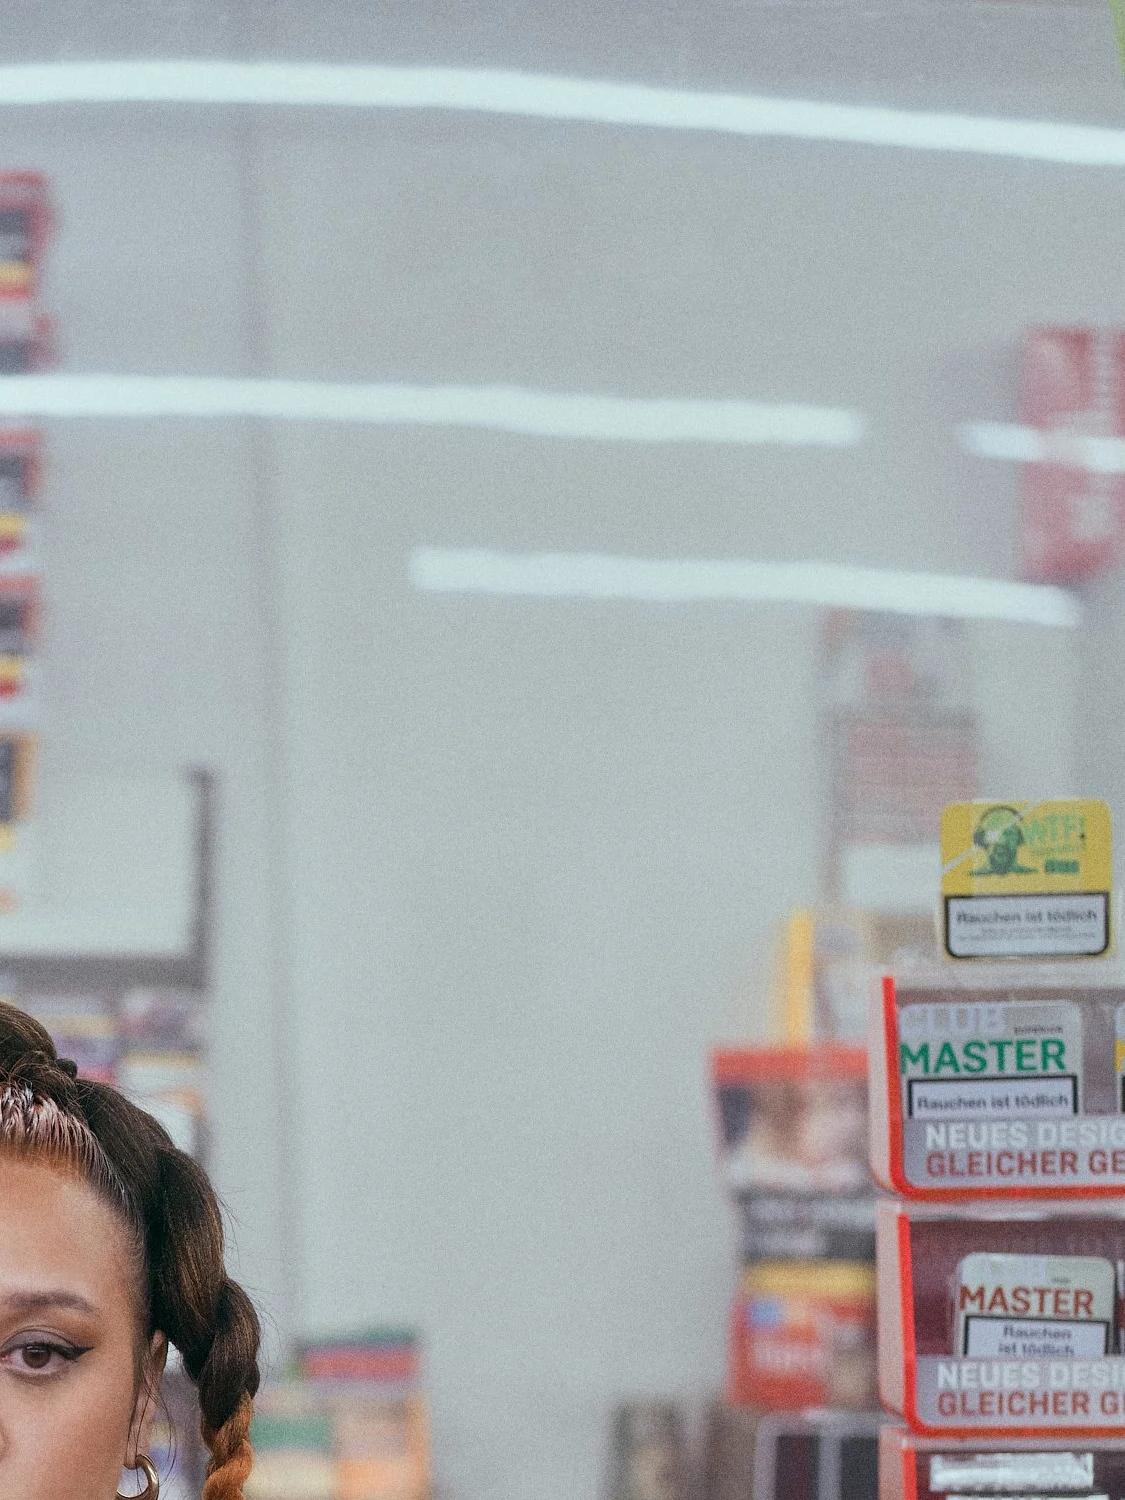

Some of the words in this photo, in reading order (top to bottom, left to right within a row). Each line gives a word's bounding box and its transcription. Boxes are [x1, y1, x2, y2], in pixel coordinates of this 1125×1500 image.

[956, 911, 1021, 925] Rauchen
[1026, 911, 1043, 923] ist
[1047, 908, 1097, 923] tödlich
[900, 1038, 1067, 1073] MASTER
[918, 1096, 987, 1110] Rauchen
[991, 1096, 1010, 1108] ist
[1015, 1094, 1069, 1108] tödlich
[926, 1122, 1028, 1149] NEUES
[926, 1150, 1079, 1178] GLEICHER
[959, 1284, 1095, 1317] MASTER
[1004, 1324, 1073, 1340] Rauchen
[999, 1343, 1017, 1356] ist
[1022, 1341, 1074, 1357] tödlich
[937, 1361, 1041, 1390] NEUES
[937, 1390, 1092, 1418] GLEICHER
